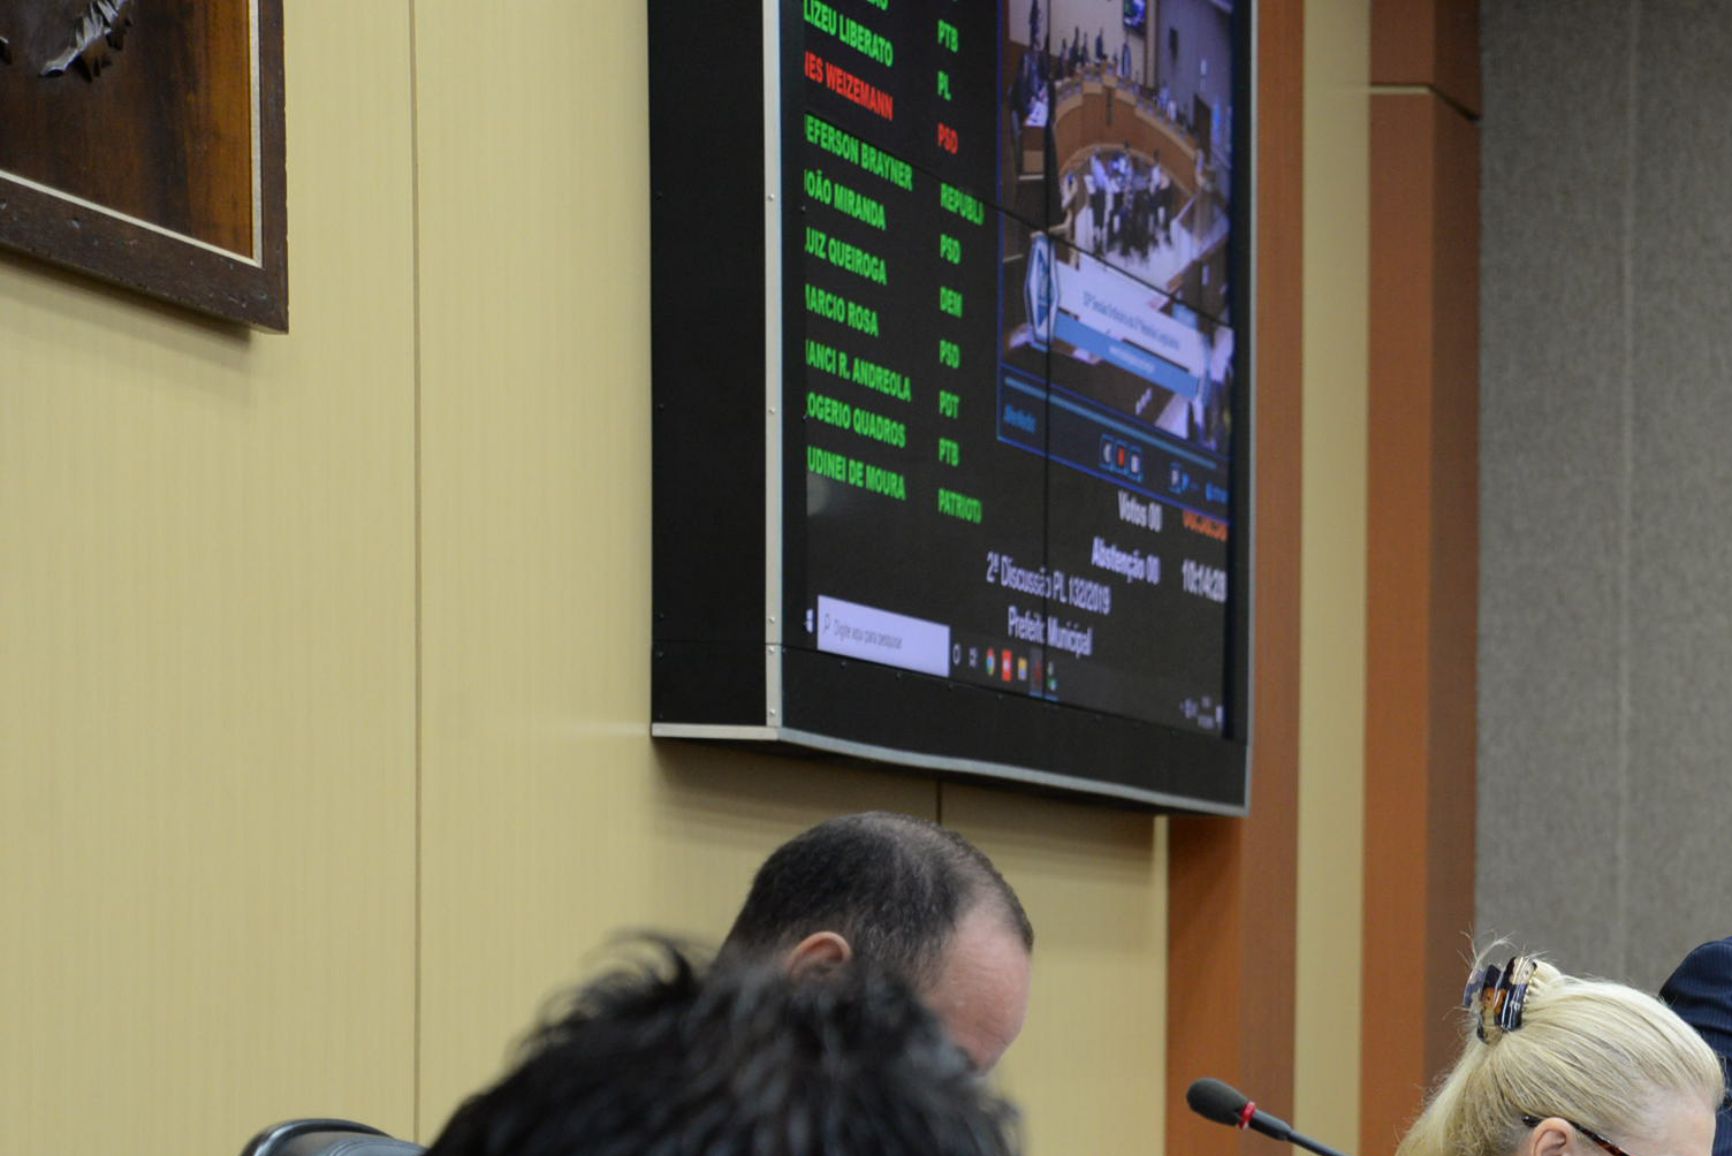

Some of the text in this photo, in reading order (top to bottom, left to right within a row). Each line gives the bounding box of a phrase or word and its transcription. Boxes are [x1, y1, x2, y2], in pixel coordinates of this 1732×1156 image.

[839, 14, 894, 67] LIBERATO
[938, 19, 959, 52] PTB
[804, 51, 894, 121] ES WEIZEMANN
[938, 70, 952, 101] PL
[804, 113, 913, 191] EFERSON BRAYNER
[938, 122, 958, 154] PSD
[834, 183, 887, 231] MIRANDA
[805, 226, 888, 286] UIZ QUEIROGA
[940, 233, 961, 265] PSD
[847, 301, 879, 337] ROSA
[940, 286, 963, 318] DEM
[805, 338, 912, 402] ANCI R. ANDREOLA
[940, 339, 960, 369] PSD
[807, 391, 906, 449] OGERIO QUADROS
[939, 390, 960, 419] PDT
[939, 437, 960, 467] PTB
[807, 445, 906, 501] UDINEI DE MOURA
[1117, 490, 1148, 527] Votos
[1091, 536, 1146, 583] Abstenção
[1053, 570, 1067, 603] PL
[1008, 606, 1093, 659] Prefeit Municipal
